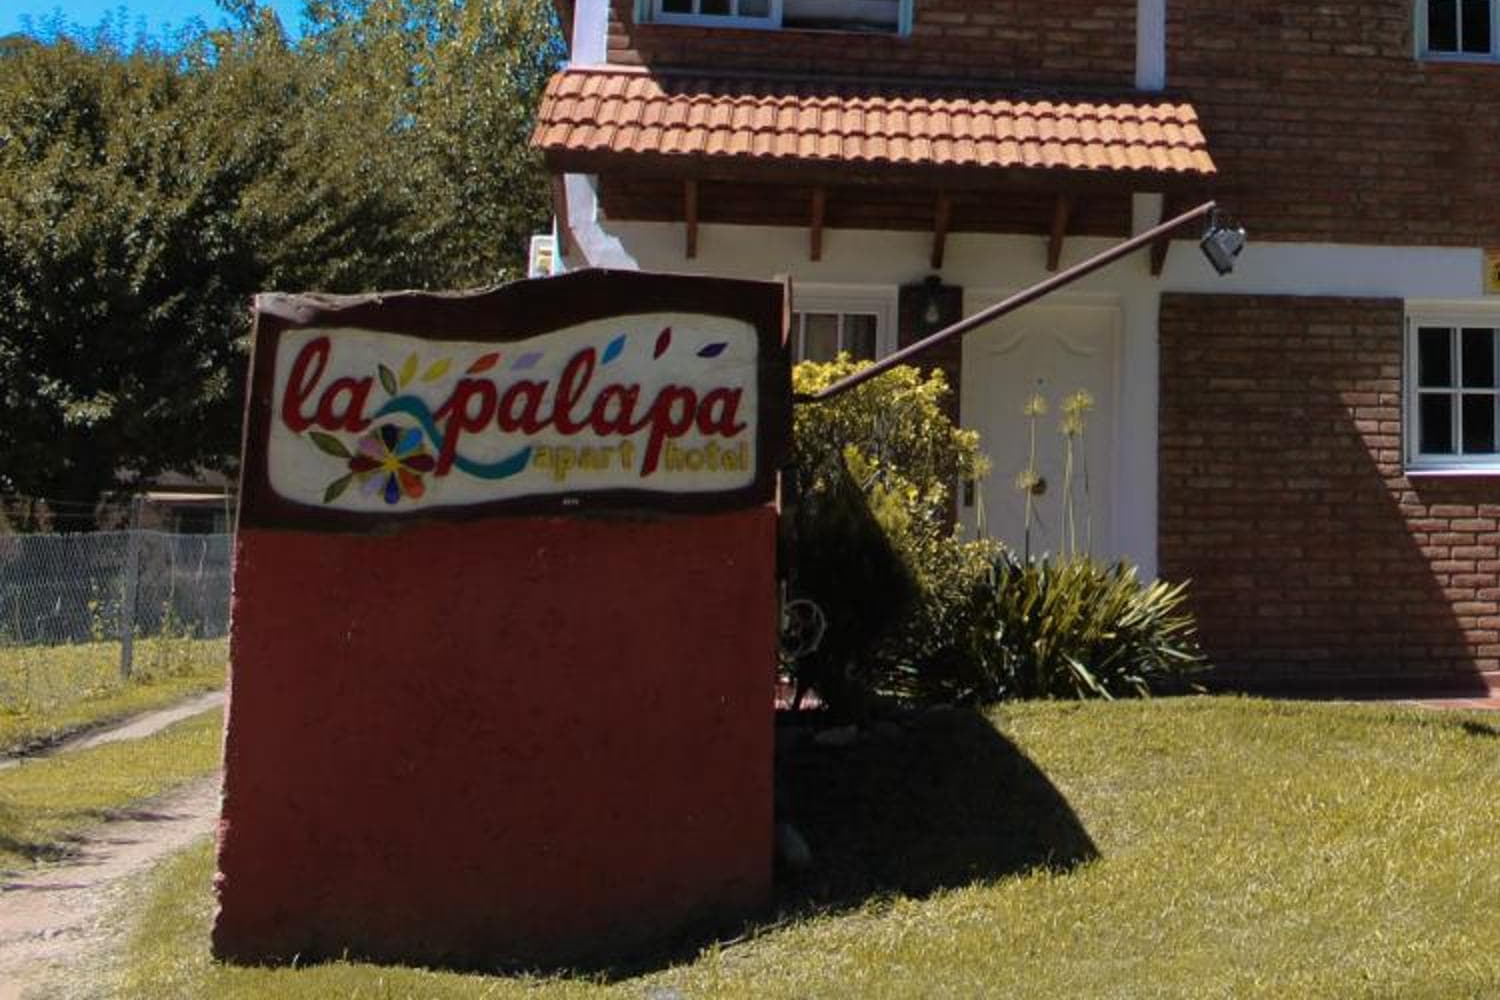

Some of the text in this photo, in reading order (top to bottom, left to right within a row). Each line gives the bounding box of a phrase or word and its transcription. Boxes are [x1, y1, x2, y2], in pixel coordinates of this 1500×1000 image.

[281, 336, 746, 476] la palapa
[532, 439, 748, 481] apart hotel
